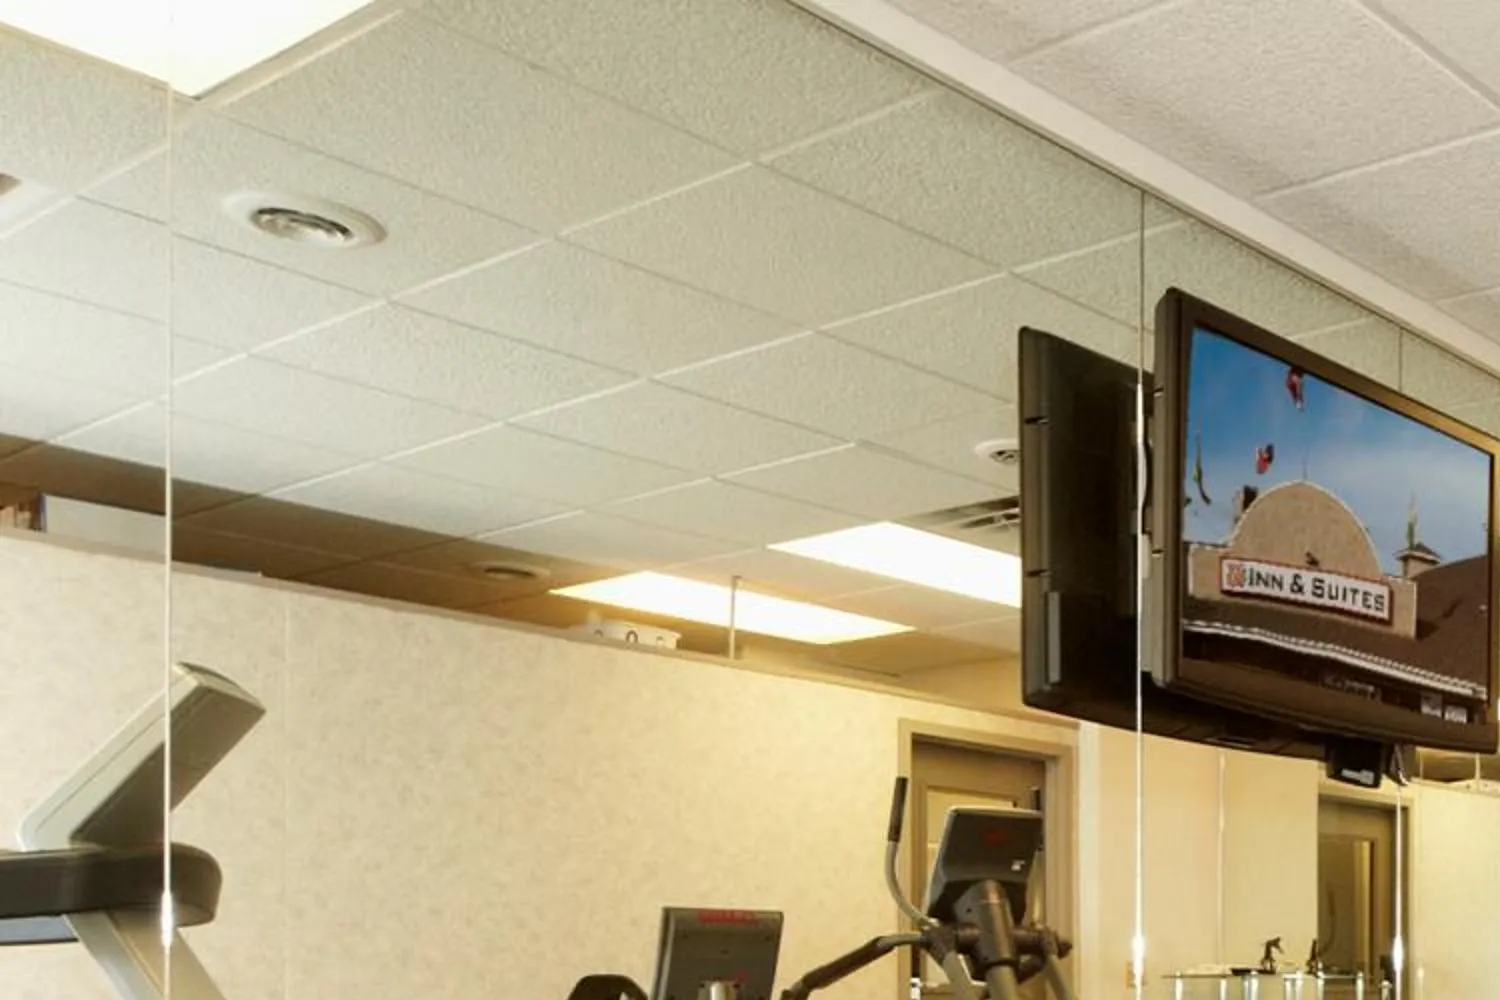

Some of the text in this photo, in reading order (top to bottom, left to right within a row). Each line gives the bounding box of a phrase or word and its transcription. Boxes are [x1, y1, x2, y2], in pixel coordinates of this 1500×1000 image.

[1248, 567, 1385, 612] INN & SUITES
